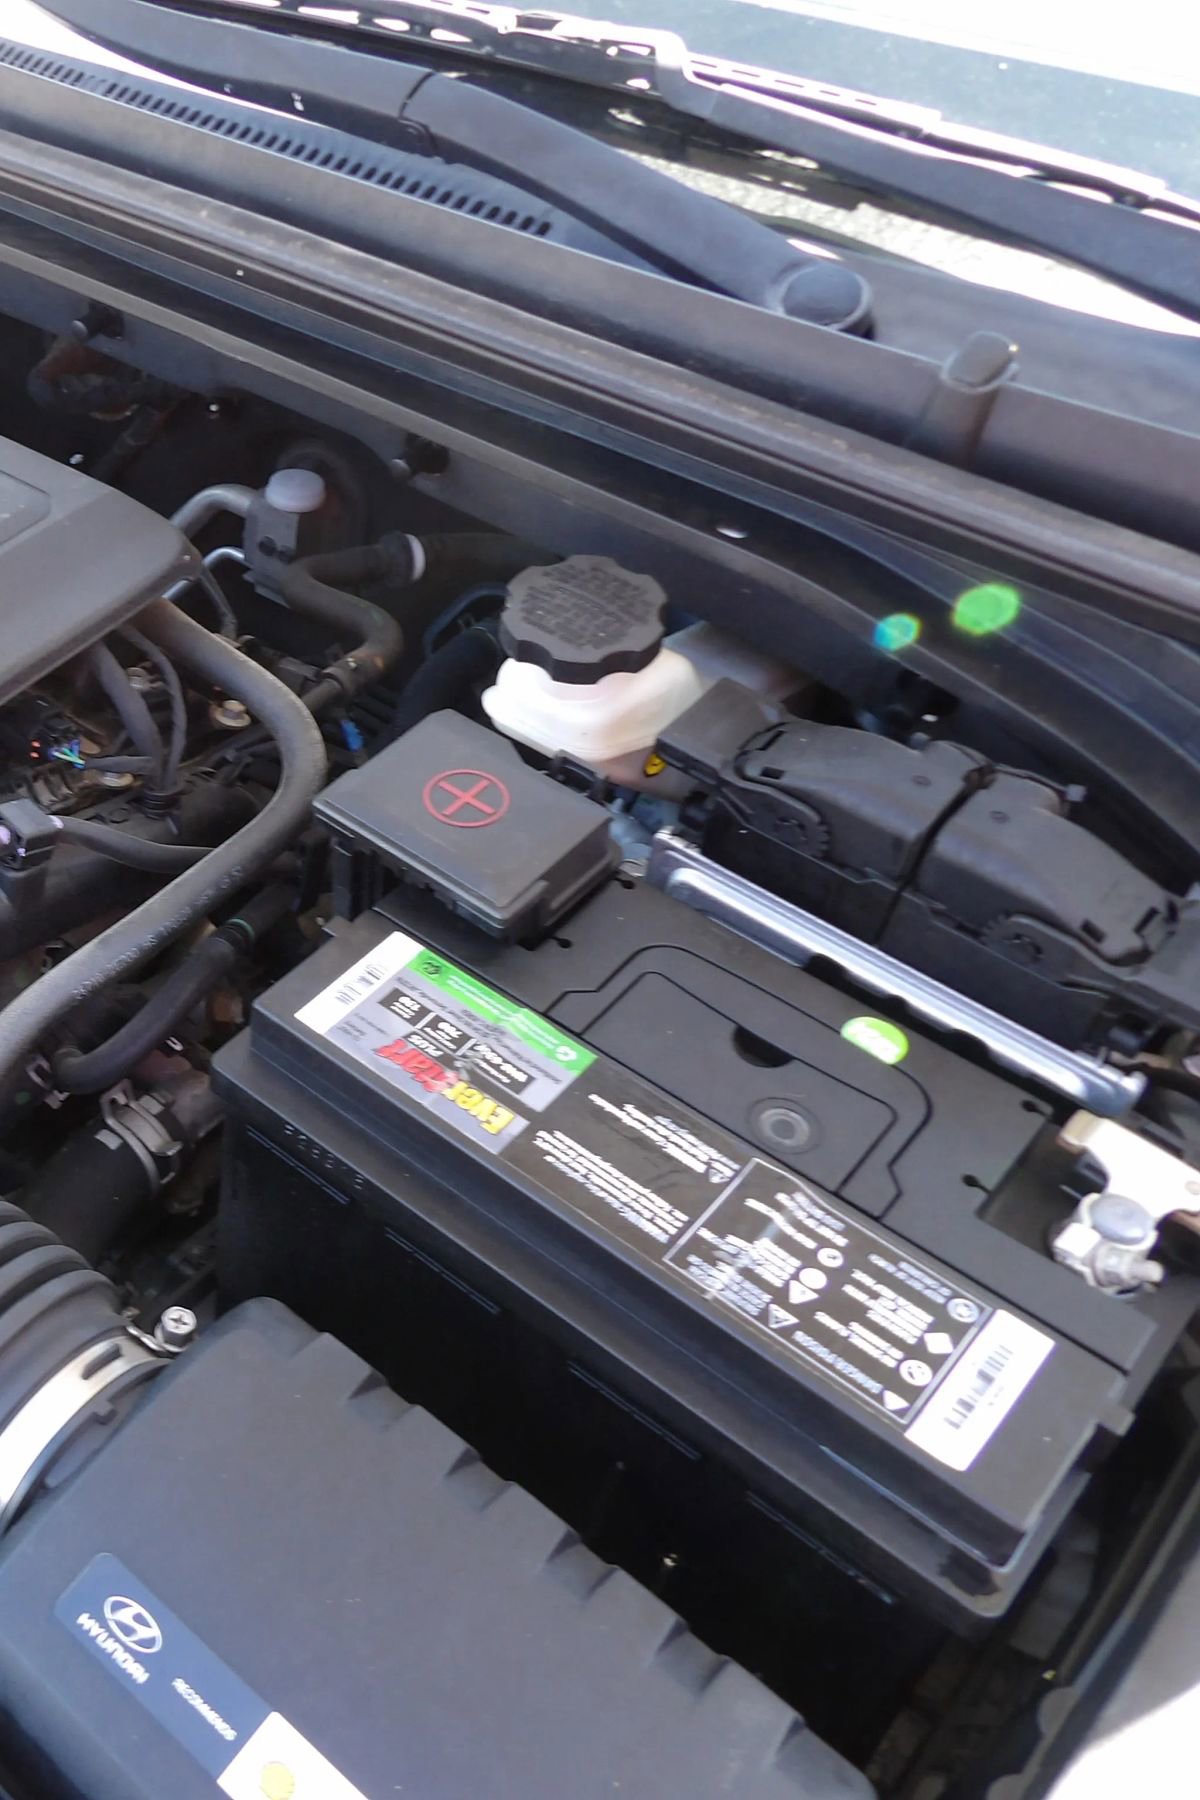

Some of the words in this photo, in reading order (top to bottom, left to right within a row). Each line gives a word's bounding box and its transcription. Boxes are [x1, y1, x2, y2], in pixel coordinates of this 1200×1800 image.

[407, 1034, 444, 1057] PLUS
[375, 1039, 515, 1135] EverStart
[76, 1612, 151, 1685] HYUNDAI
